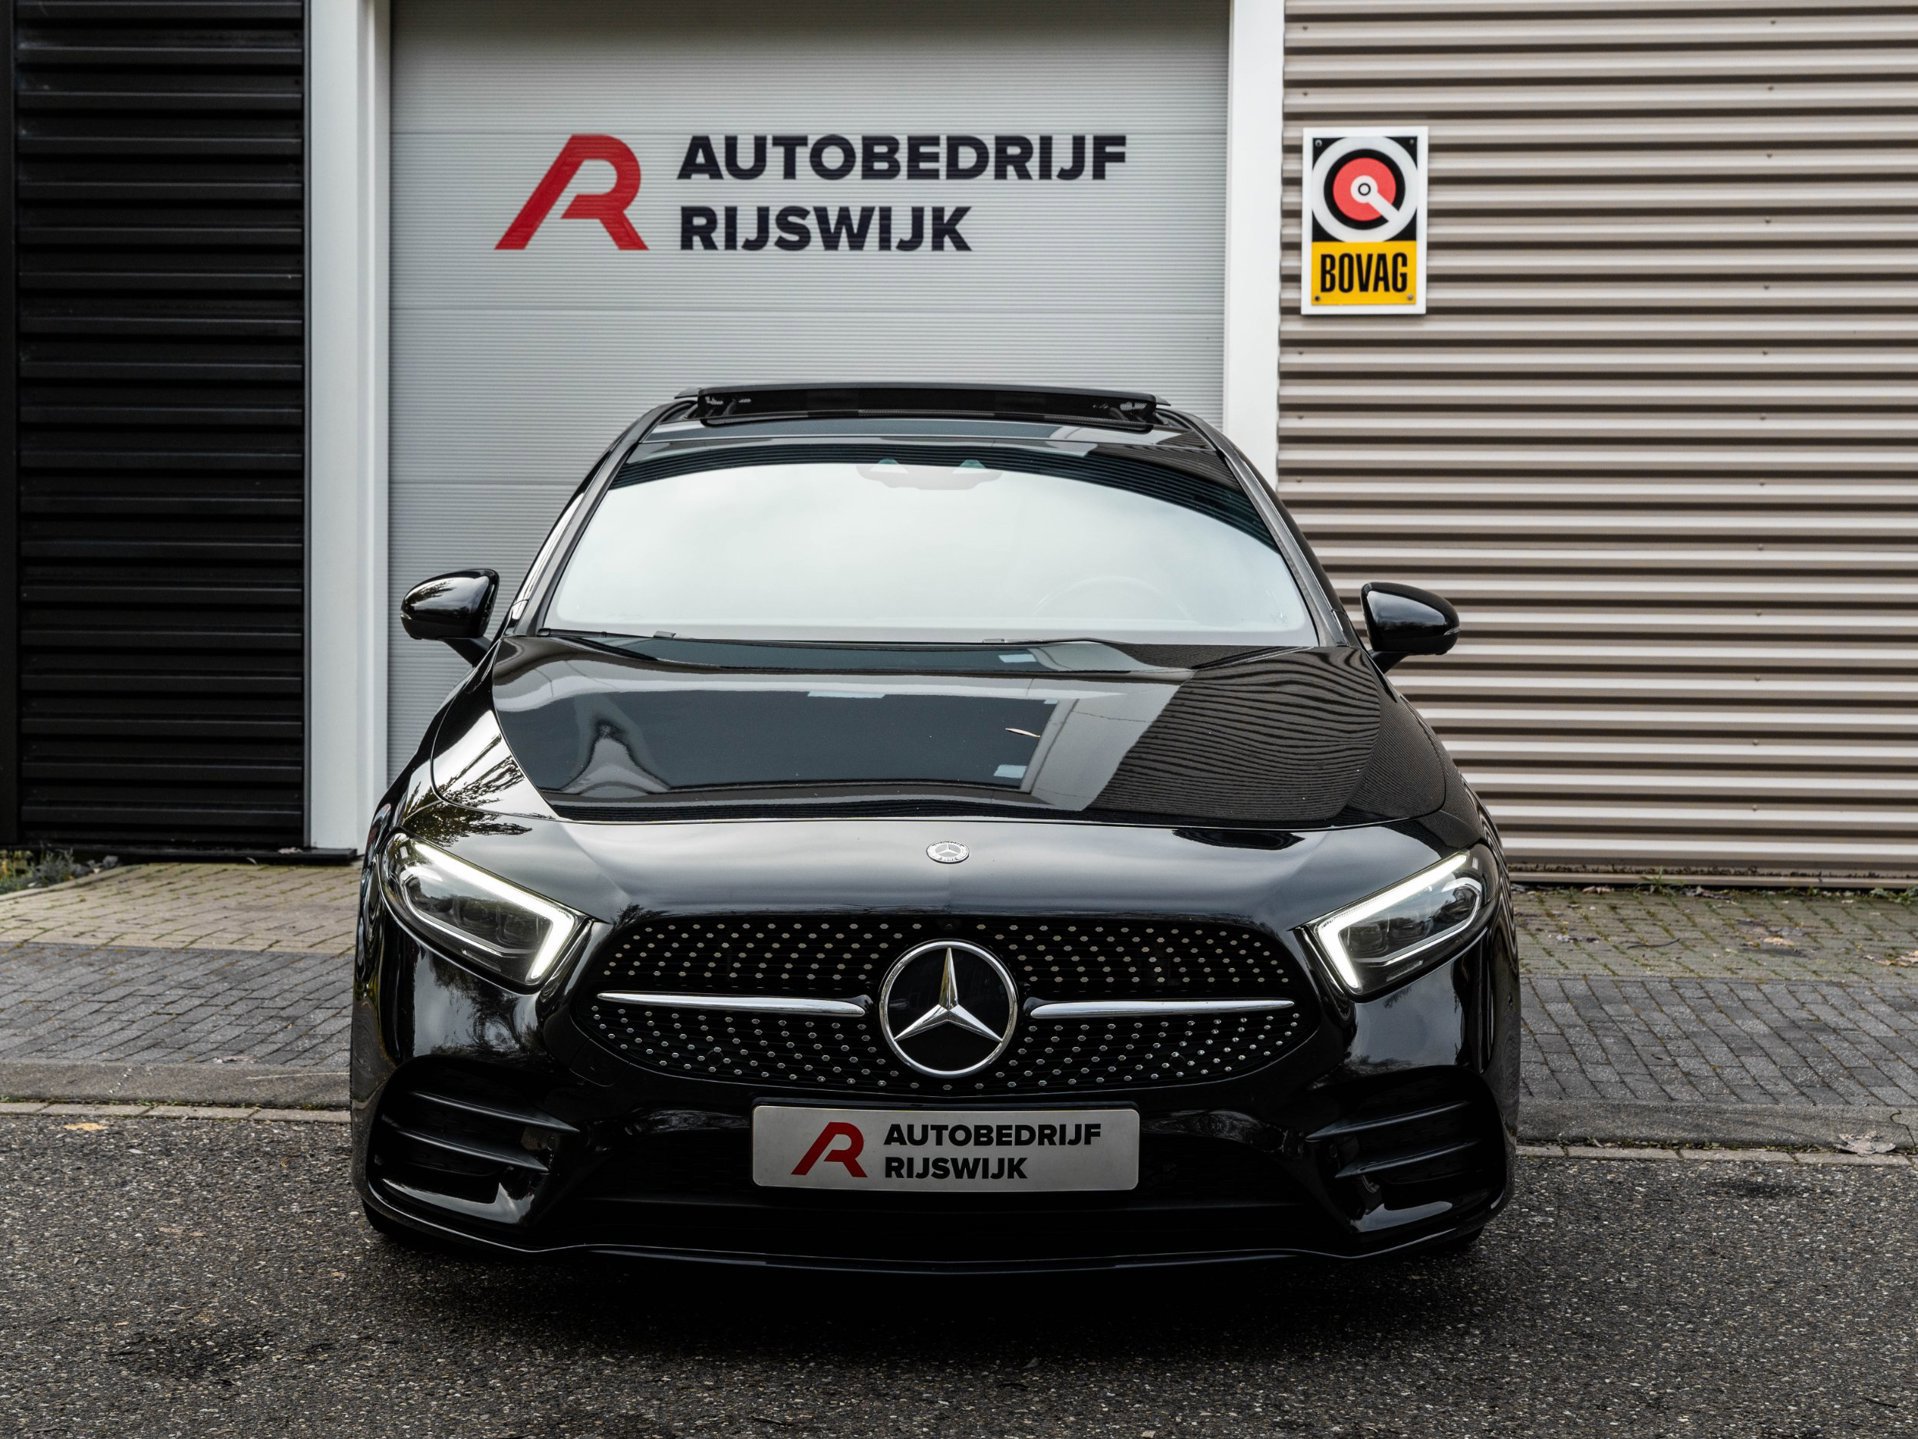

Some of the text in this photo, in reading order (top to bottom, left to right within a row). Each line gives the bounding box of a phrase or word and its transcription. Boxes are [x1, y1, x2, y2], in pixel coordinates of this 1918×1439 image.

[677, 134, 1127, 181] AUTOBEDRIJF
[680, 206, 973, 252] RIJSWIJK
[1320, 252, 1409, 294] BOVAG
[883, 1123, 1103, 1148] AUTOBEDRIJF
[884, 1156, 1030, 1180] RIJSWIJK
